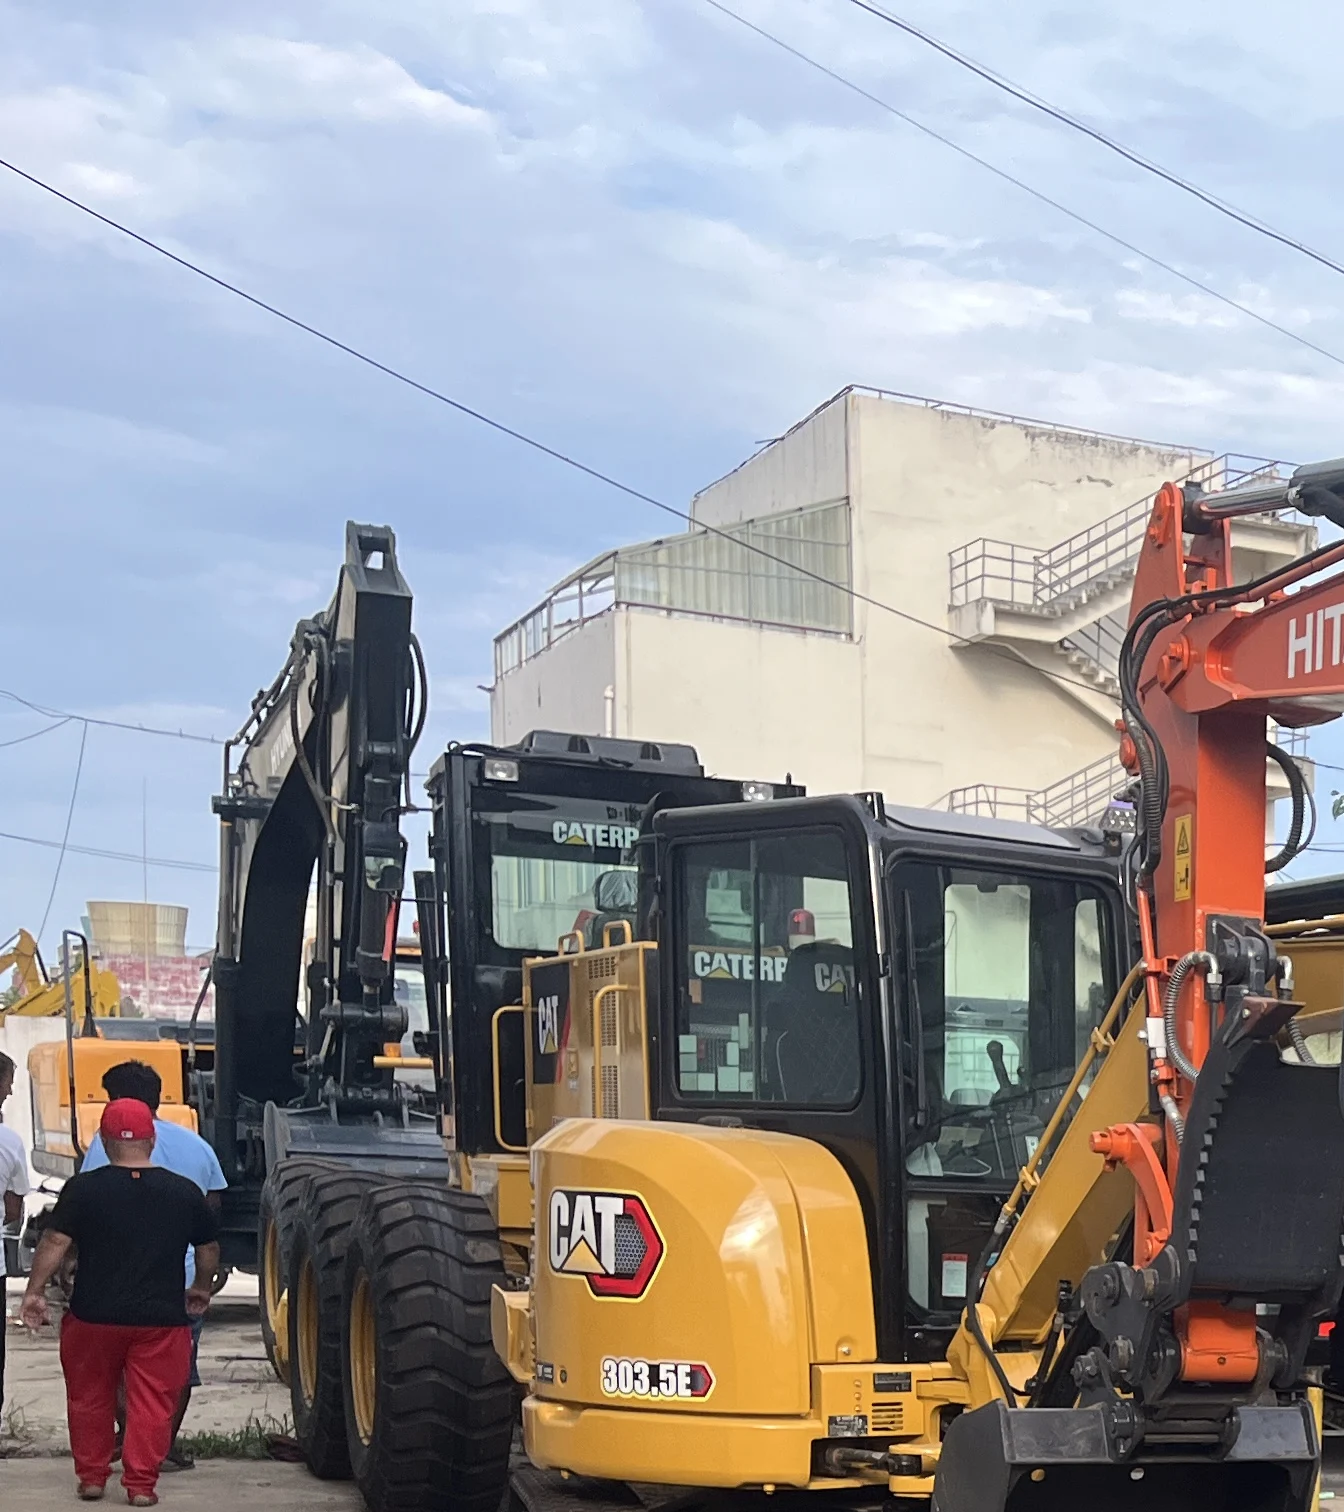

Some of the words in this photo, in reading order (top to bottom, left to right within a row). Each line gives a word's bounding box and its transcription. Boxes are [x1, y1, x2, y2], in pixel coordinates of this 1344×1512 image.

[552, 821, 639, 849] CATERP
[538, 995, 558, 1055] CAT
[550, 1191, 623, 1275] CAT
[602, 1359, 692, 1397] 303.5E
